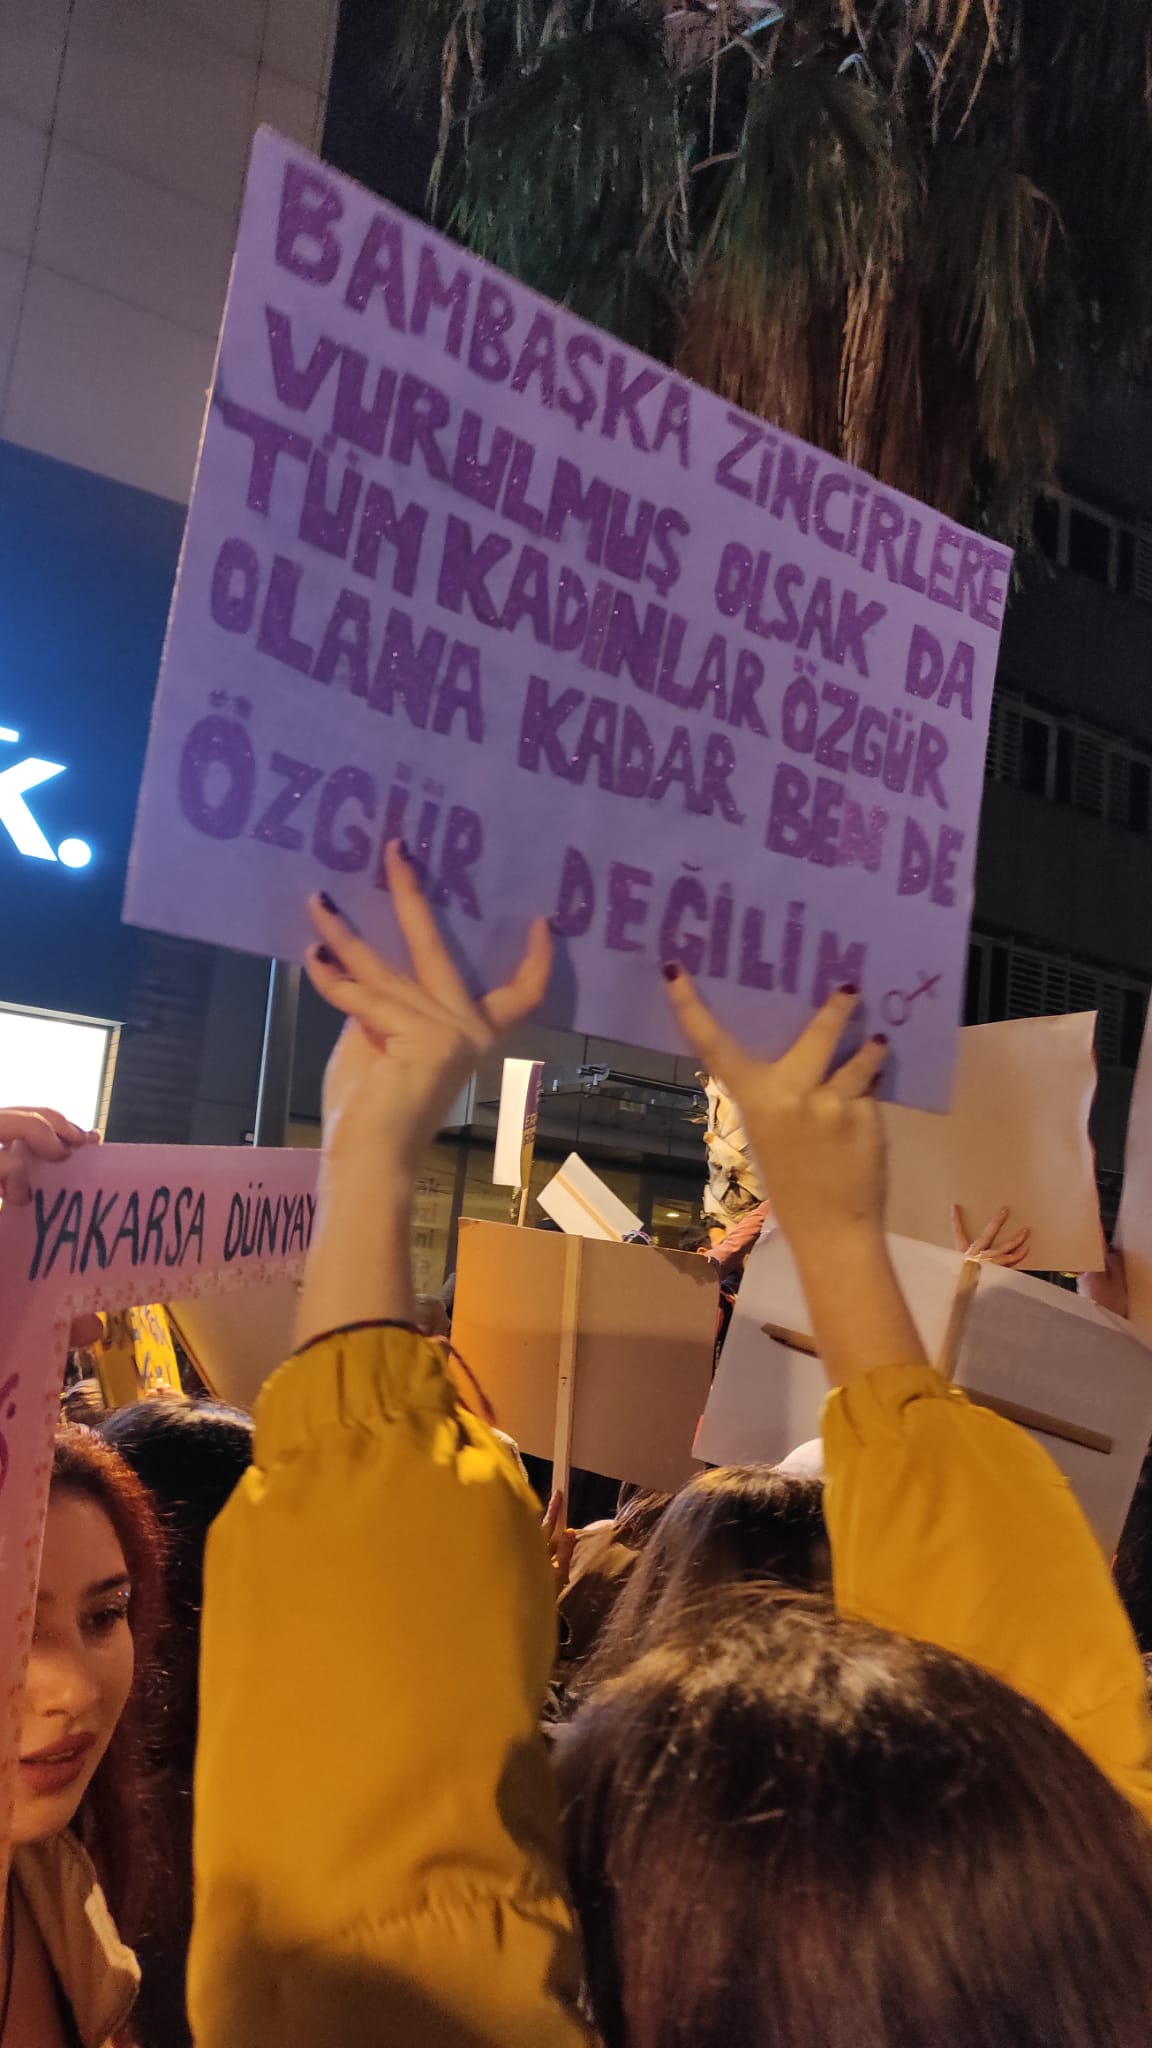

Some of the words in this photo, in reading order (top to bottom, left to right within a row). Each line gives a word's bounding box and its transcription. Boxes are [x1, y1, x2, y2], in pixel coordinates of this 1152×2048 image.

[265, 303, 690, 598] VURULMUŞ
[714, 541, 887, 678] OLSAK
[904, 624, 975, 720] DA
[276, 158, 692, 470] BAMBAŞKA
[714, 411, 1010, 631] ZİNCİRLERE
[210, 537, 484, 744] OLANA
[517, 674, 745, 826] KADAR
[764, 761, 889, 873] BEN
[897, 816, 965, 907] DE
[221, 400, 429, 598] TÜM
[436, 512, 770, 738] KADINLAR
[781, 656, 950, 811] ÖZGÜR
[178, 689, 484, 921] ÖZGÜR
[550, 845, 868, 1008] DEĞİLİM
[28, 1186, 205, 1281] YAKARSA
